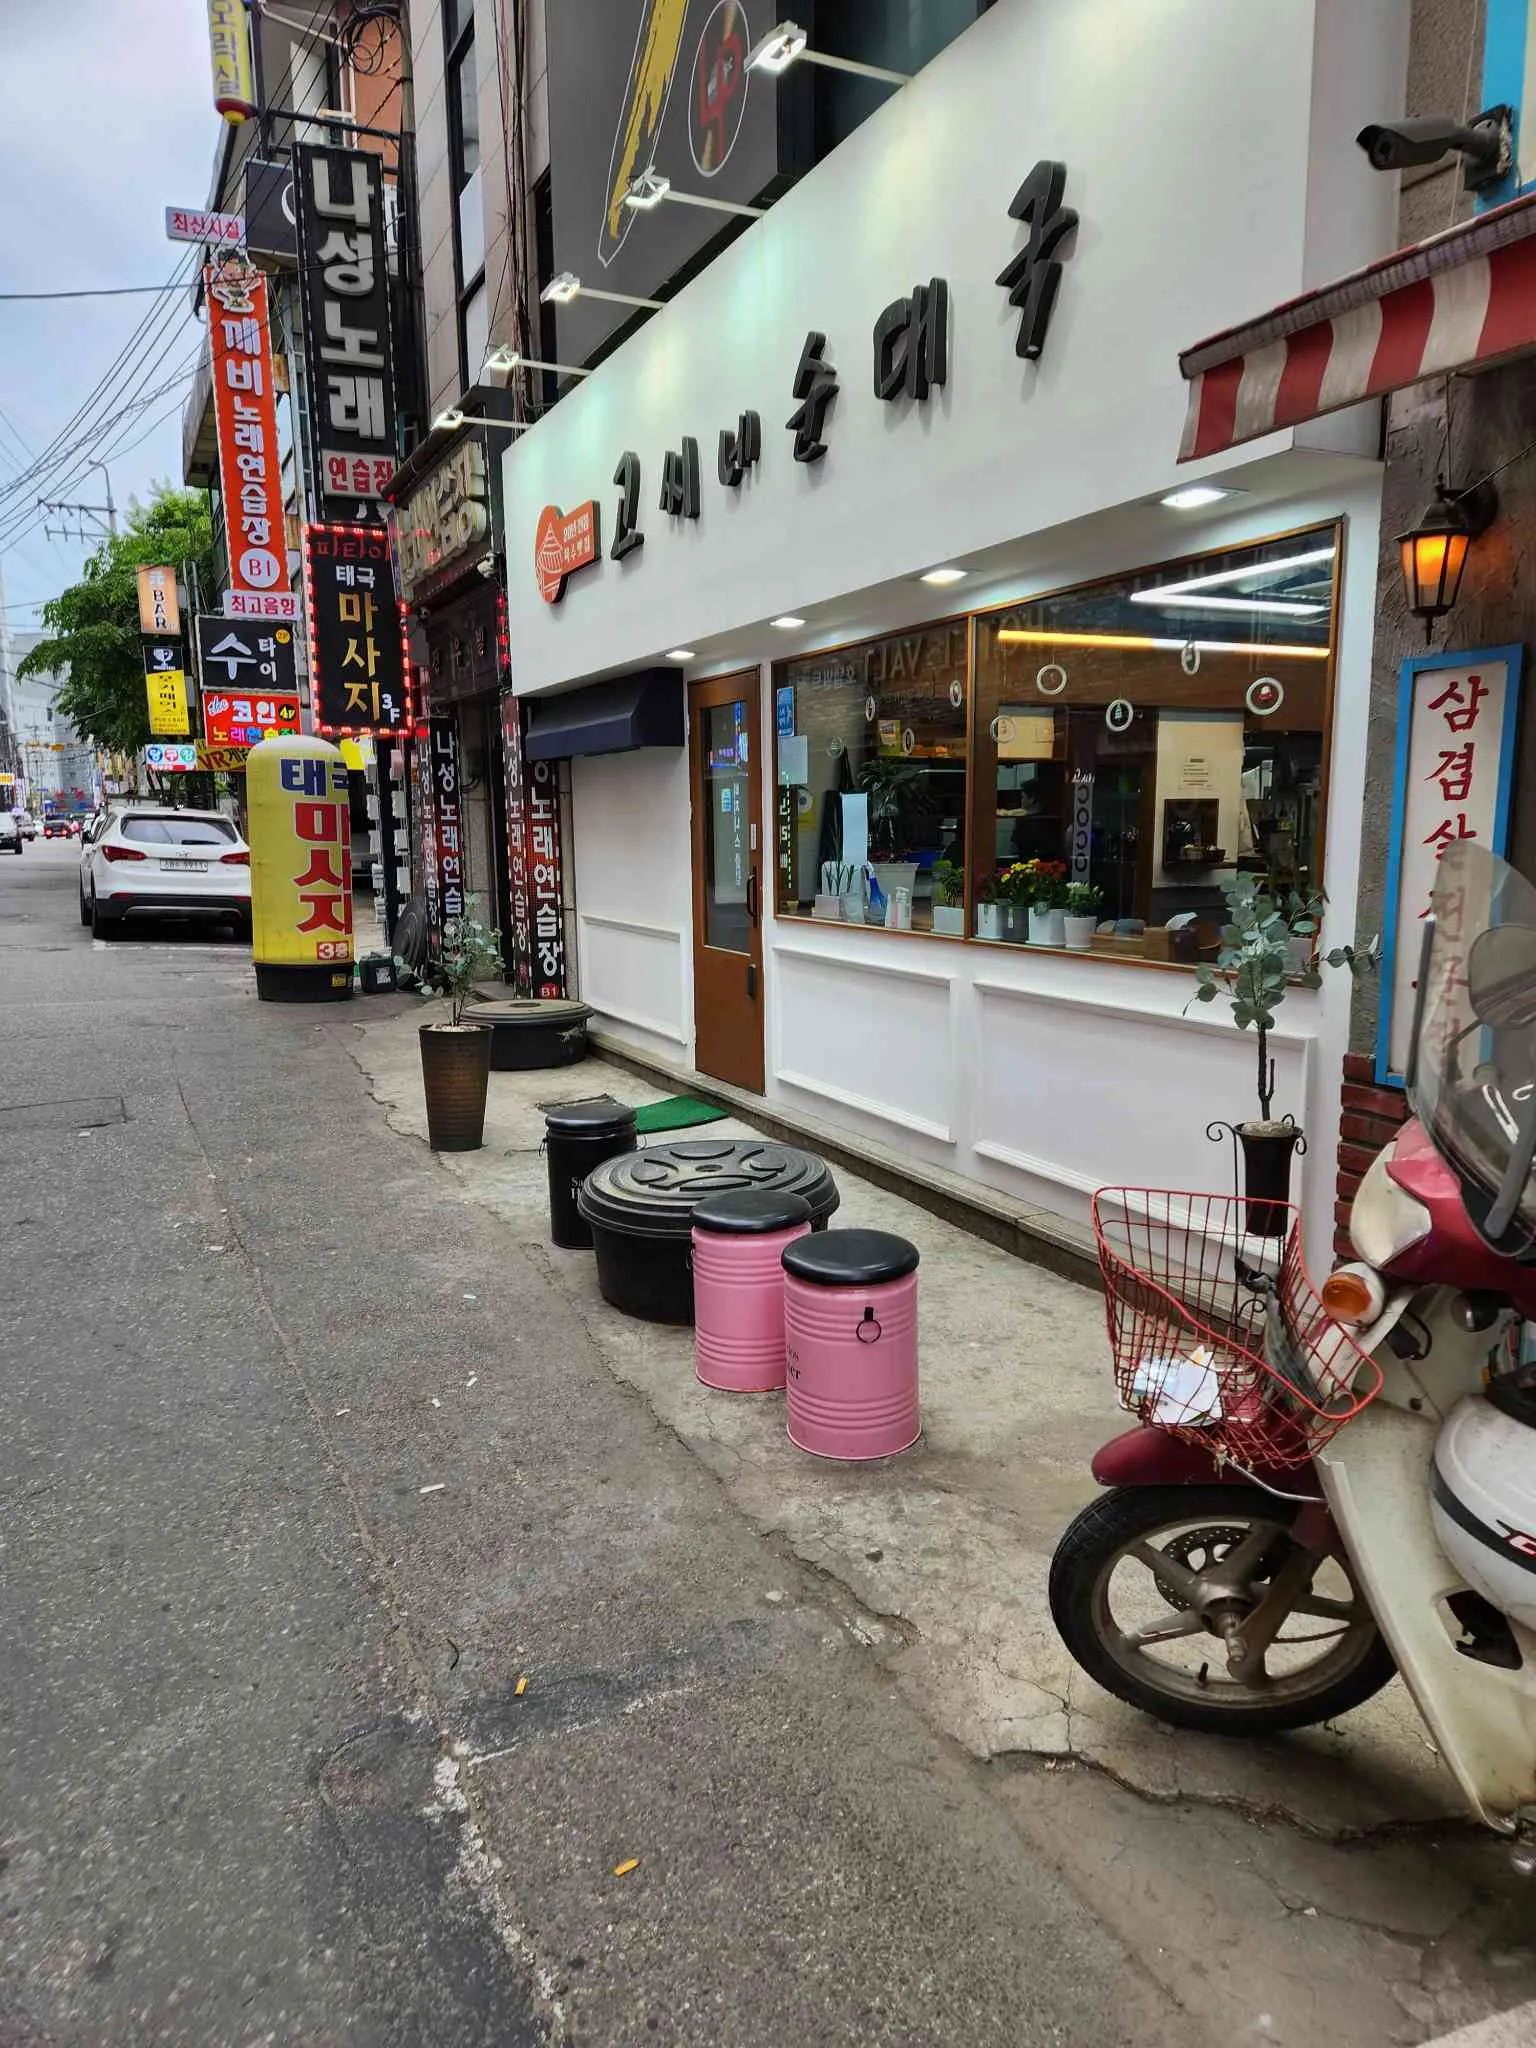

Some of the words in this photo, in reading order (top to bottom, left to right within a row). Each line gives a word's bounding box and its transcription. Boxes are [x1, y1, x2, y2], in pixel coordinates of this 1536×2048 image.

[312, 157, 386, 439] 나성노래
[220, 317, 271, 546] 깨비노래연습장
[328, 456, 394, 494] 연습장
[335, 564, 376, 589] 태국
[153, 589, 168, 629] BAR
[206, 631, 258, 680] 수
[258, 636, 277, 682] 타이
[339, 591, 380, 721] 마사지
[232, 700, 277, 724] 코인
[381, 693, 400, 723] 3F
[436, 731, 462, 915] 나성노래연습
